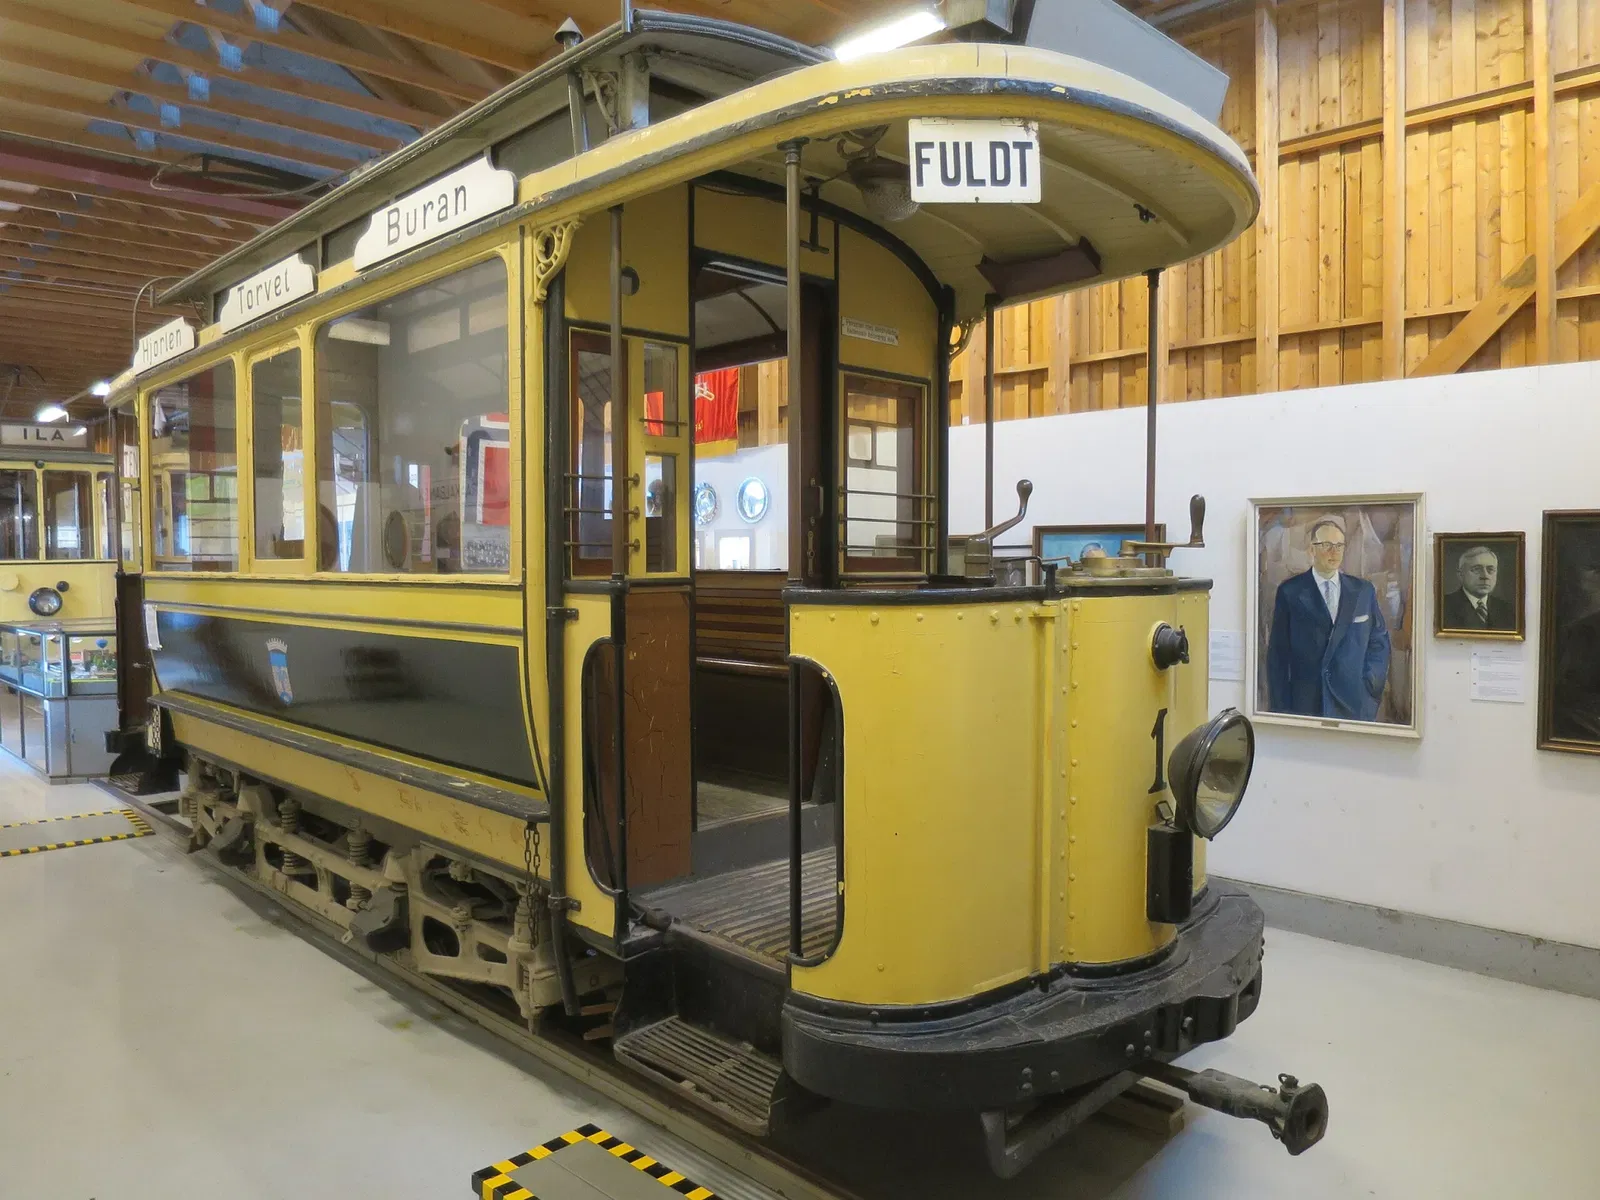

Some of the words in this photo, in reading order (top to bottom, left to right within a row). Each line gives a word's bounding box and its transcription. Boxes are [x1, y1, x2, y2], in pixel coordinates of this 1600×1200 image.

[914, 140, 1034, 188] FULDT
[386, 184, 468, 247] Buran
[237, 267, 290, 315] Torvet
[23, 427, 65, 442] ILA
